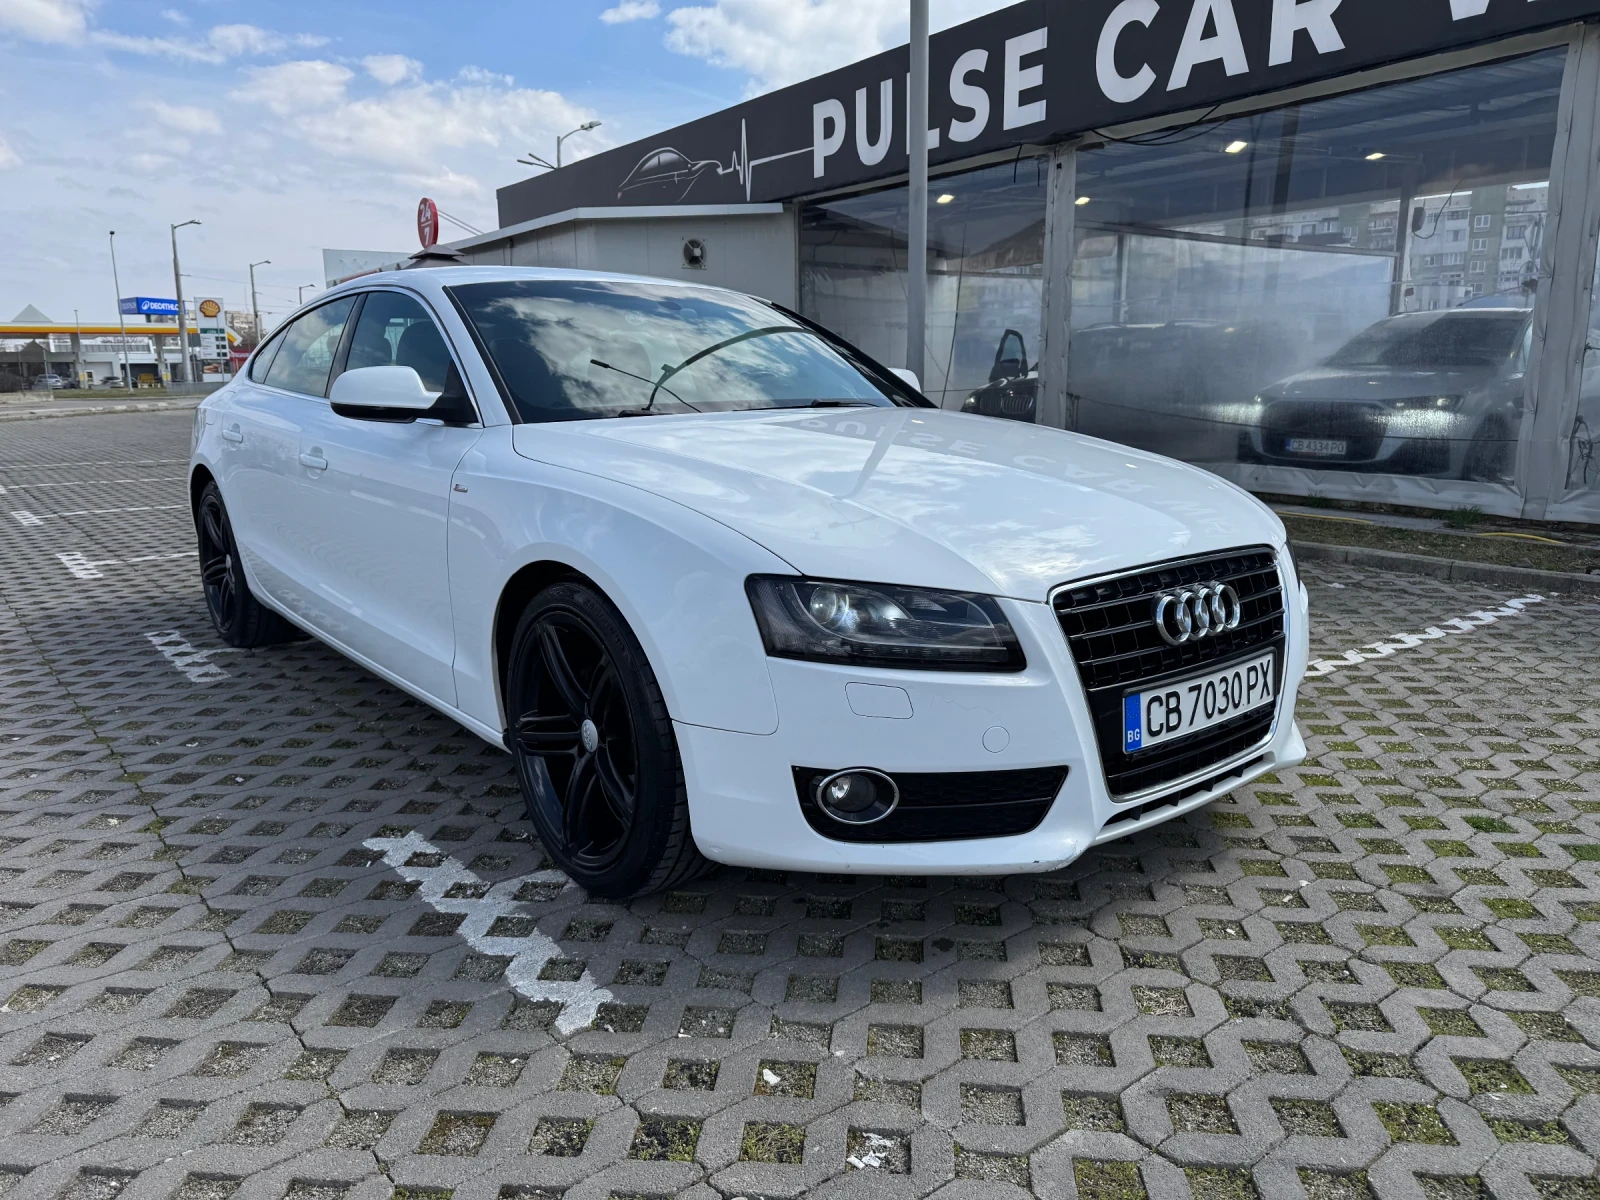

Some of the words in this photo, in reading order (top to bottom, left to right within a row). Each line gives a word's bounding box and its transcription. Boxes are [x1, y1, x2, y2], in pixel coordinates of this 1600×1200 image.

[1095, 0, 1346, 103] CAR
[420, 201, 431, 222] 24
[424, 226, 430, 246] 7
[150, 302, 179, 310] DECATHLO
[1147, 690, 1182, 737] CB
[1188, 671, 1242, 727] 7030
[1246, 659, 1271, 705] PX
[1127, 730, 1141, 743] BG
